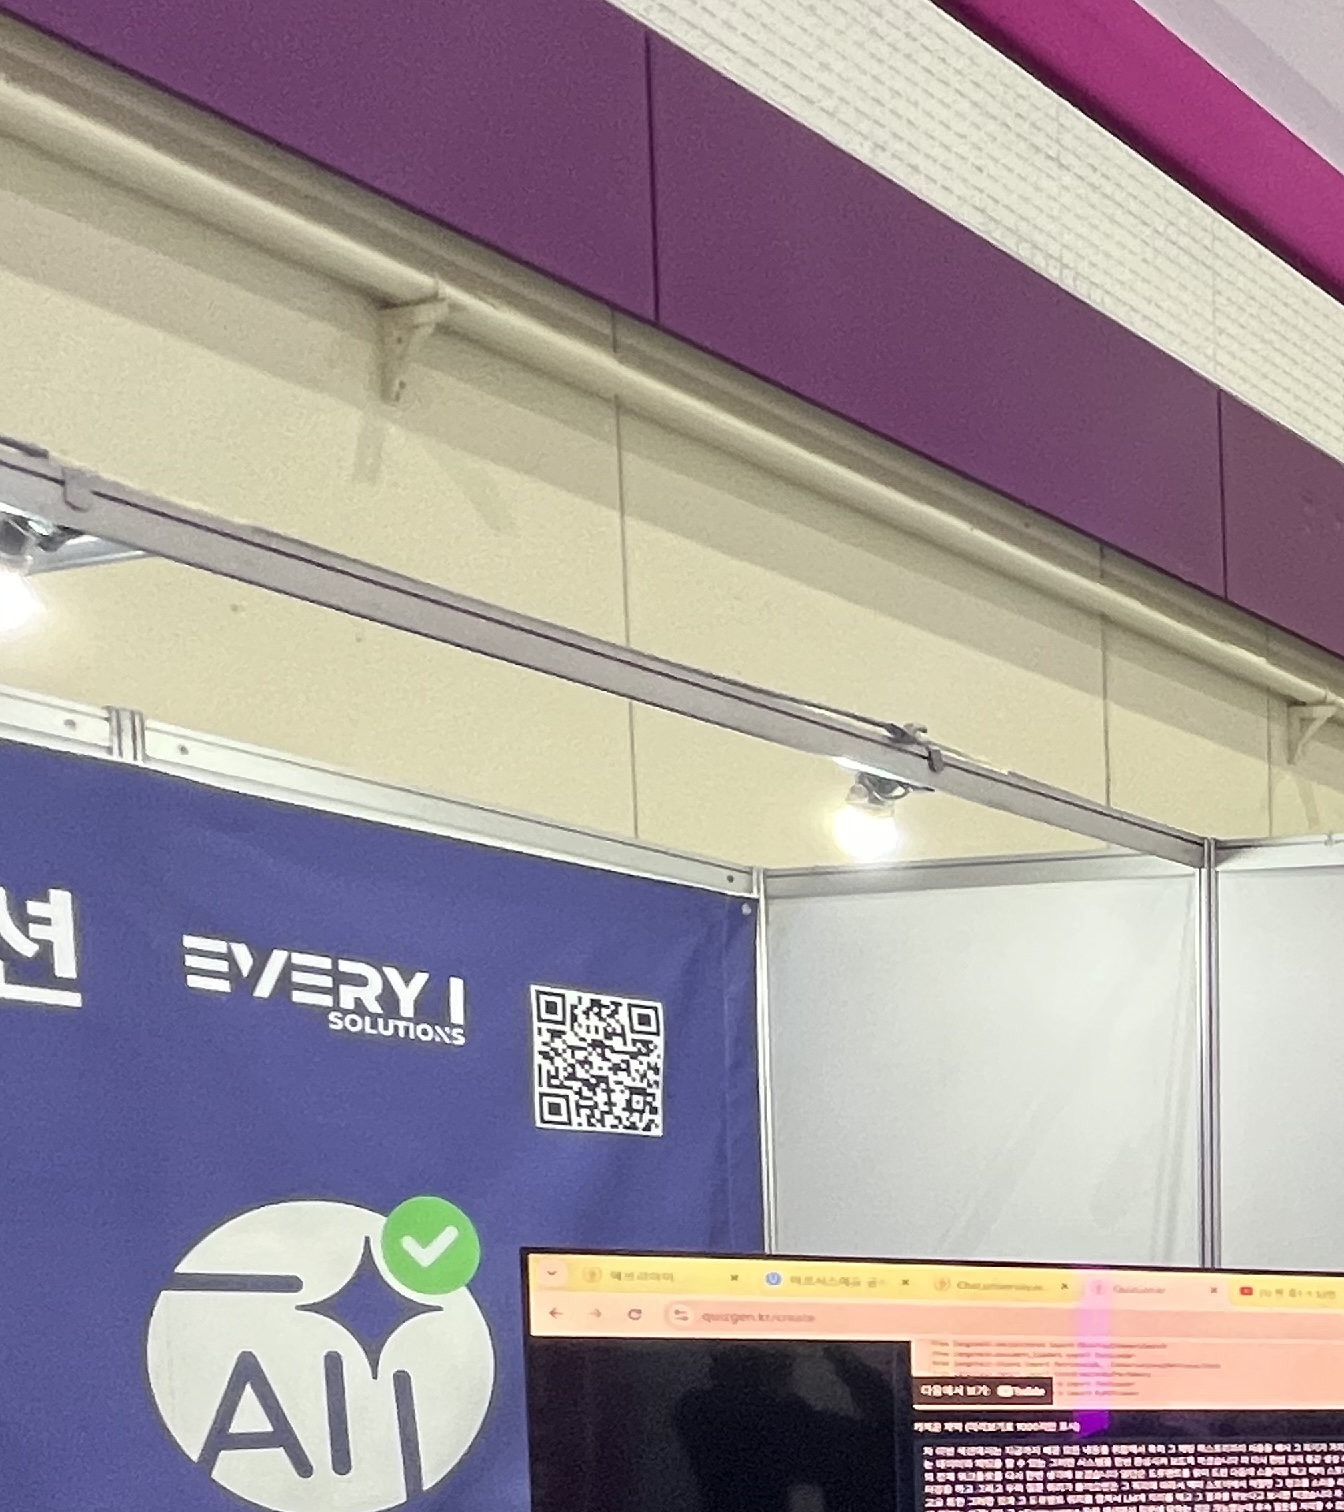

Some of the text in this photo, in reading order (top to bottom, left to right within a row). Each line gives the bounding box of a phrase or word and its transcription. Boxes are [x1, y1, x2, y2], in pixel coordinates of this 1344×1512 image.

[183, 935, 466, 1025] EVERY I
[328, 1011, 466, 1046] SOLUTIONS
